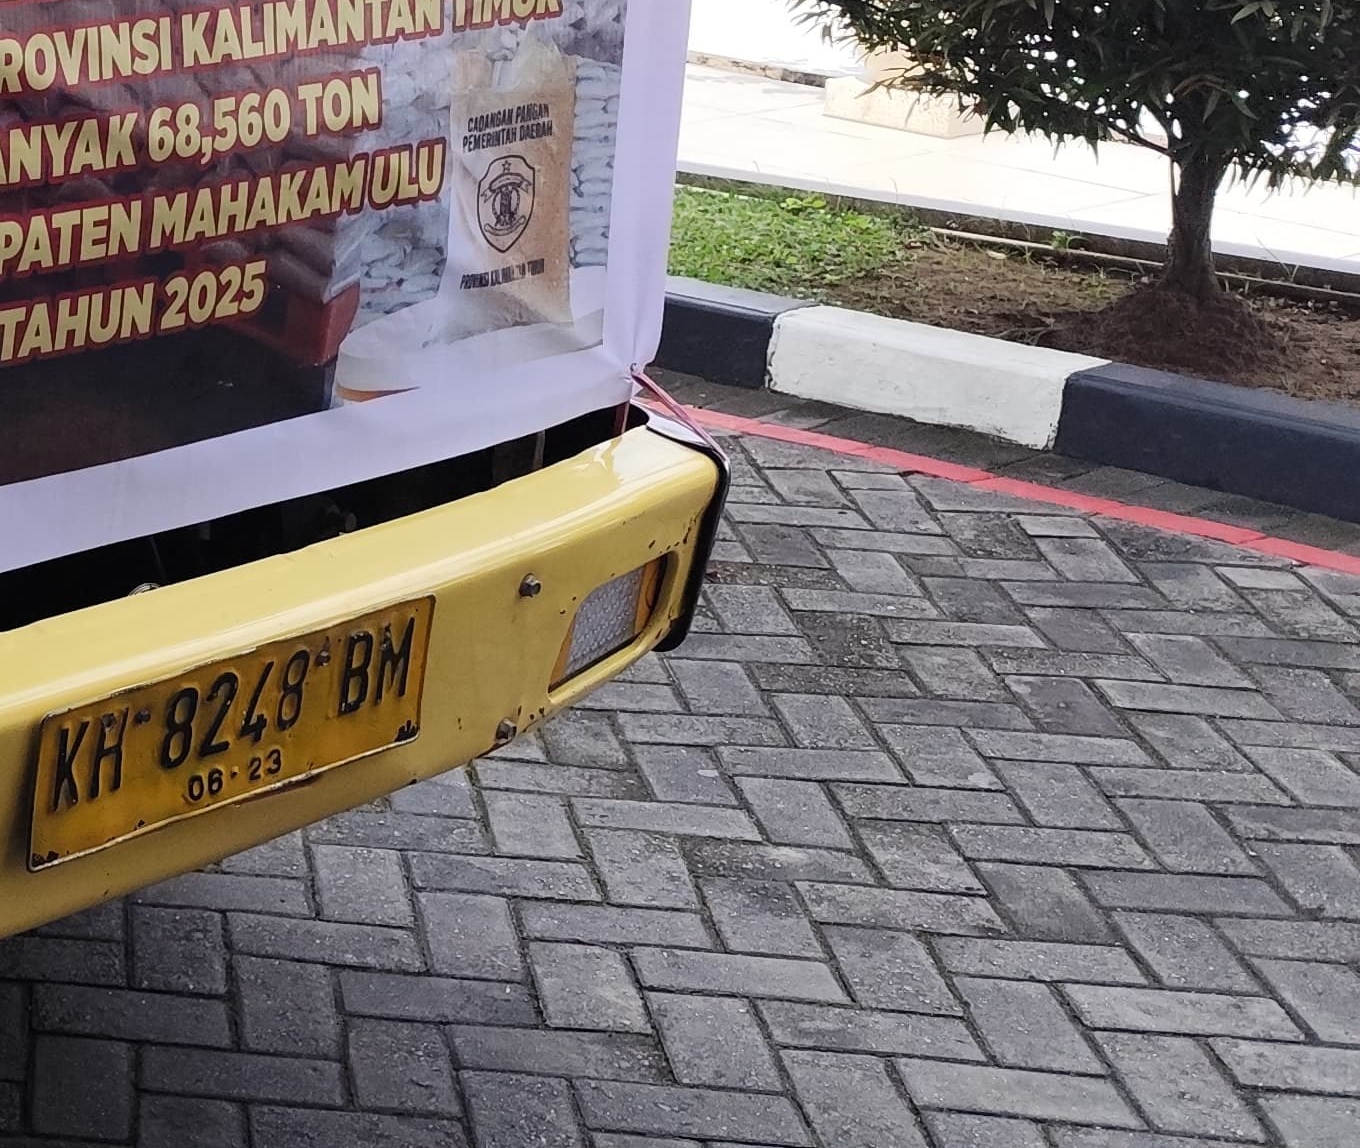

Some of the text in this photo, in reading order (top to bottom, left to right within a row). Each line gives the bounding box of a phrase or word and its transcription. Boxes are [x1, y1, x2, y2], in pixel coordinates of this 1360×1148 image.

[148, 87, 290, 164] 68,560
[298, 72, 379, 130] TON
[463, 120, 553, 152] PEMERINTAH DAERAH
[467, 102, 550, 134] CADANGAN PANGAN
[151, 165, 364, 249] MAHAKAM
[369, 141, 446, 205] ULU
[166, 264, 266, 330] 2025
[52, 617, 416, 812] KH 8248 BM
[188, 767, 223, 802] 06
[248, 748, 282, 782] 23
